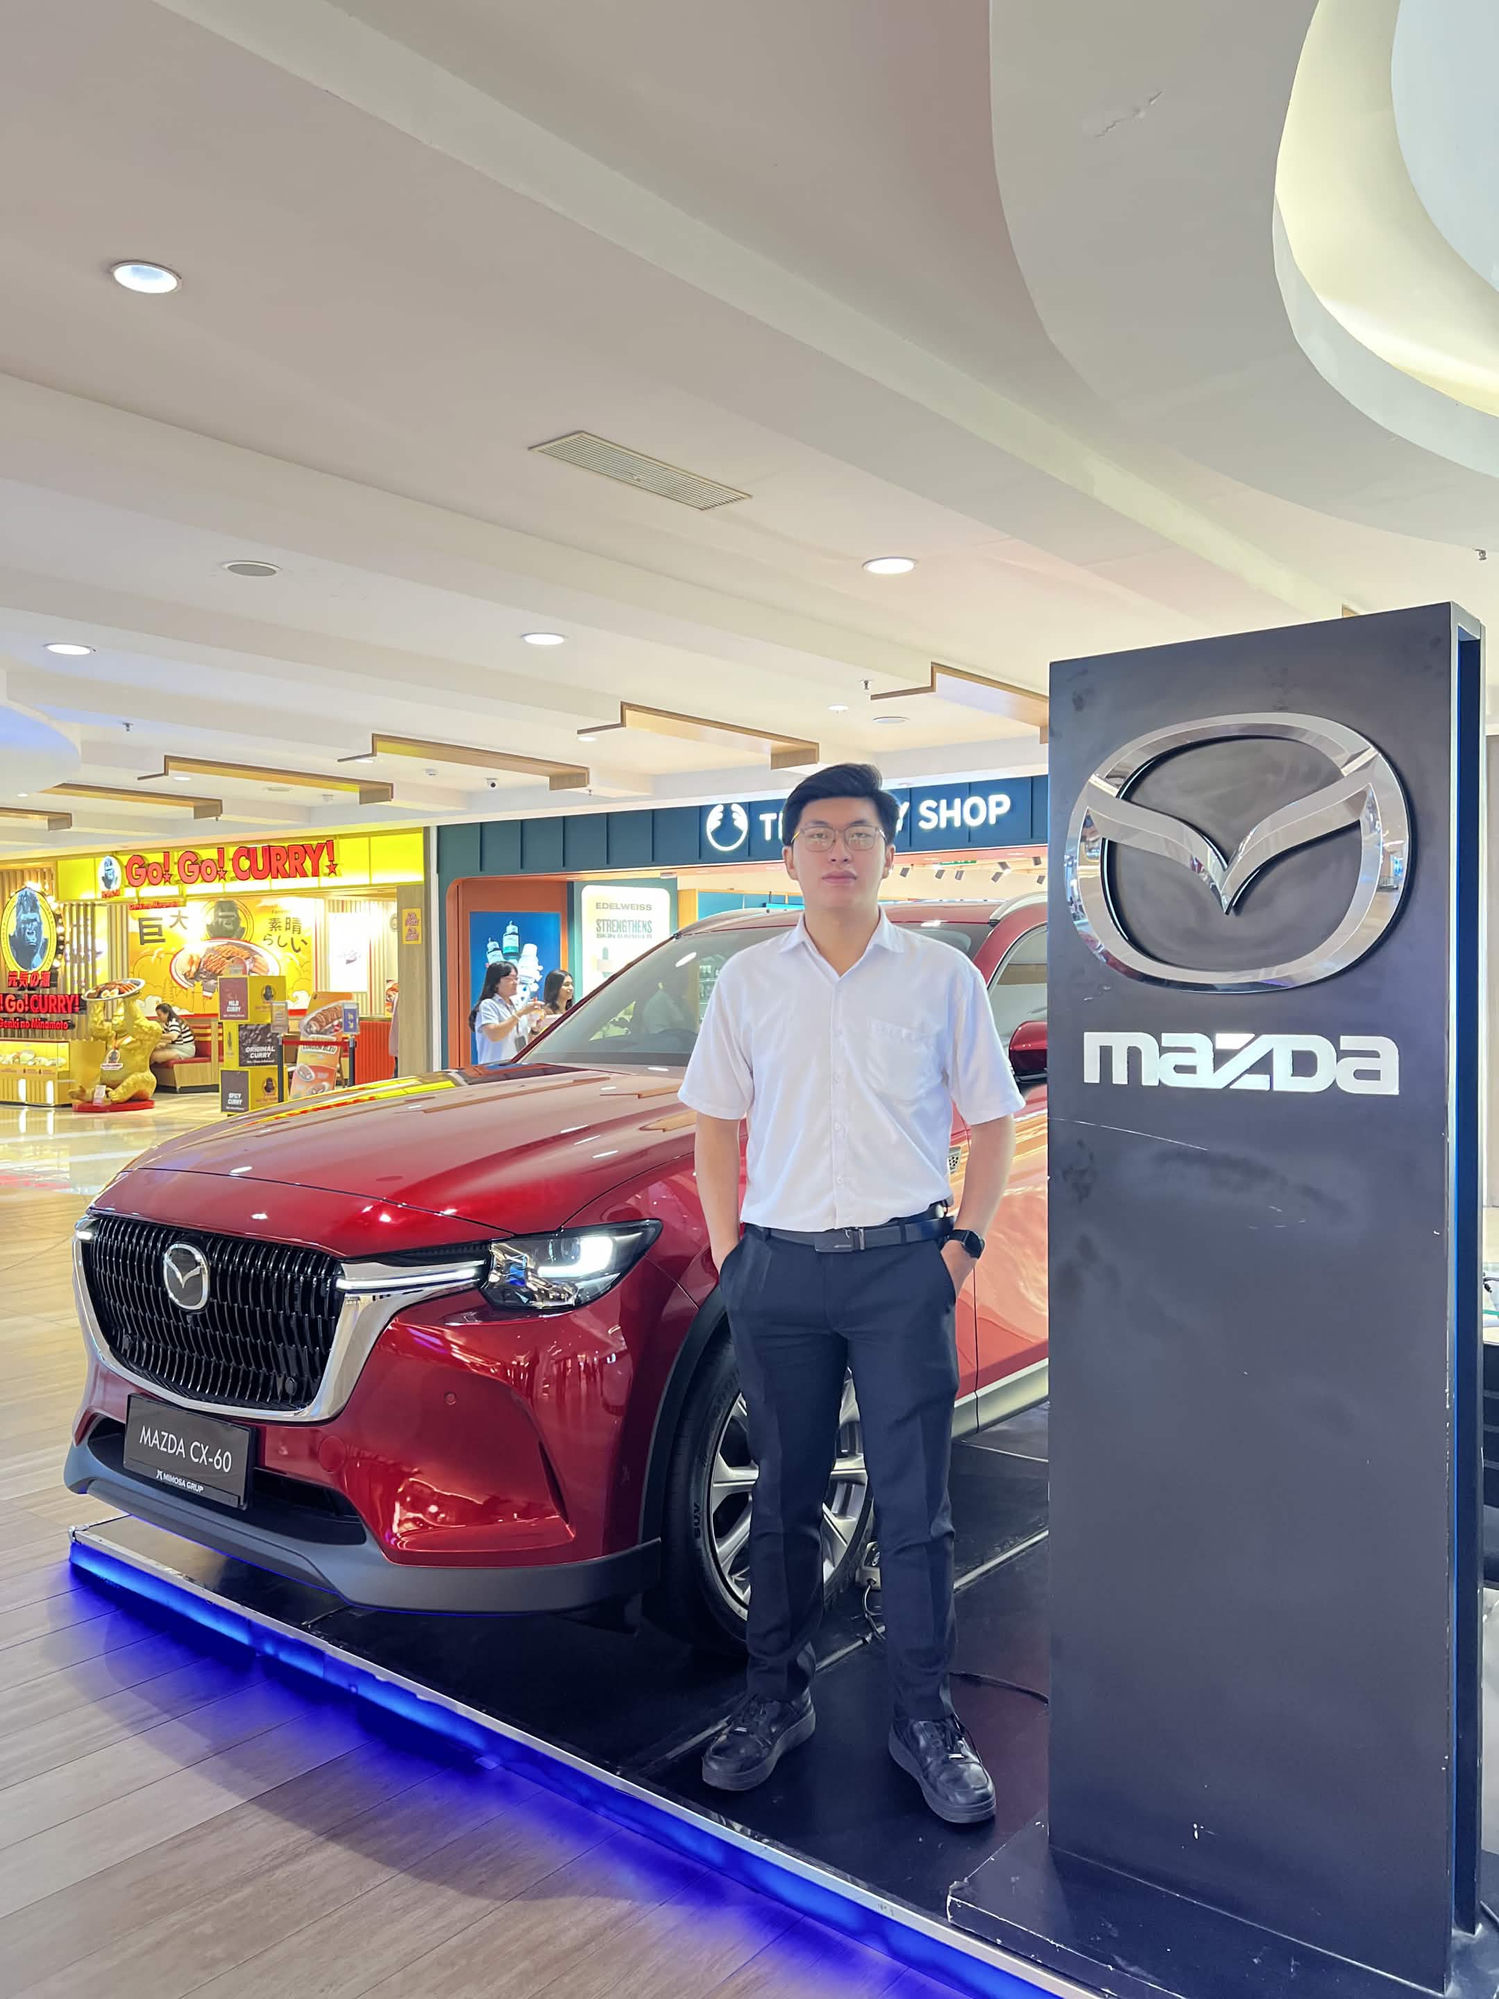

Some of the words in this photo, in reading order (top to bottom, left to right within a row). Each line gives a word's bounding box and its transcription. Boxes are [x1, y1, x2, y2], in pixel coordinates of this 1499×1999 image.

[918, 793, 1011, 831] SHOP
[126, 851, 172, 887] Go!
[177, 847, 228, 885] Go!
[231, 839, 337, 881] CURRY!
[595, 902, 652, 911] EDELWEISS
[596, 919, 653, 933] STRENGTHENS
[30, 994, 79, 1014] CURRY!
[139, 1425, 185, 1458] MAZDA
[190, 1441, 232, 1473] CX-60
[163, 1472, 187, 1489] MIMOSA
